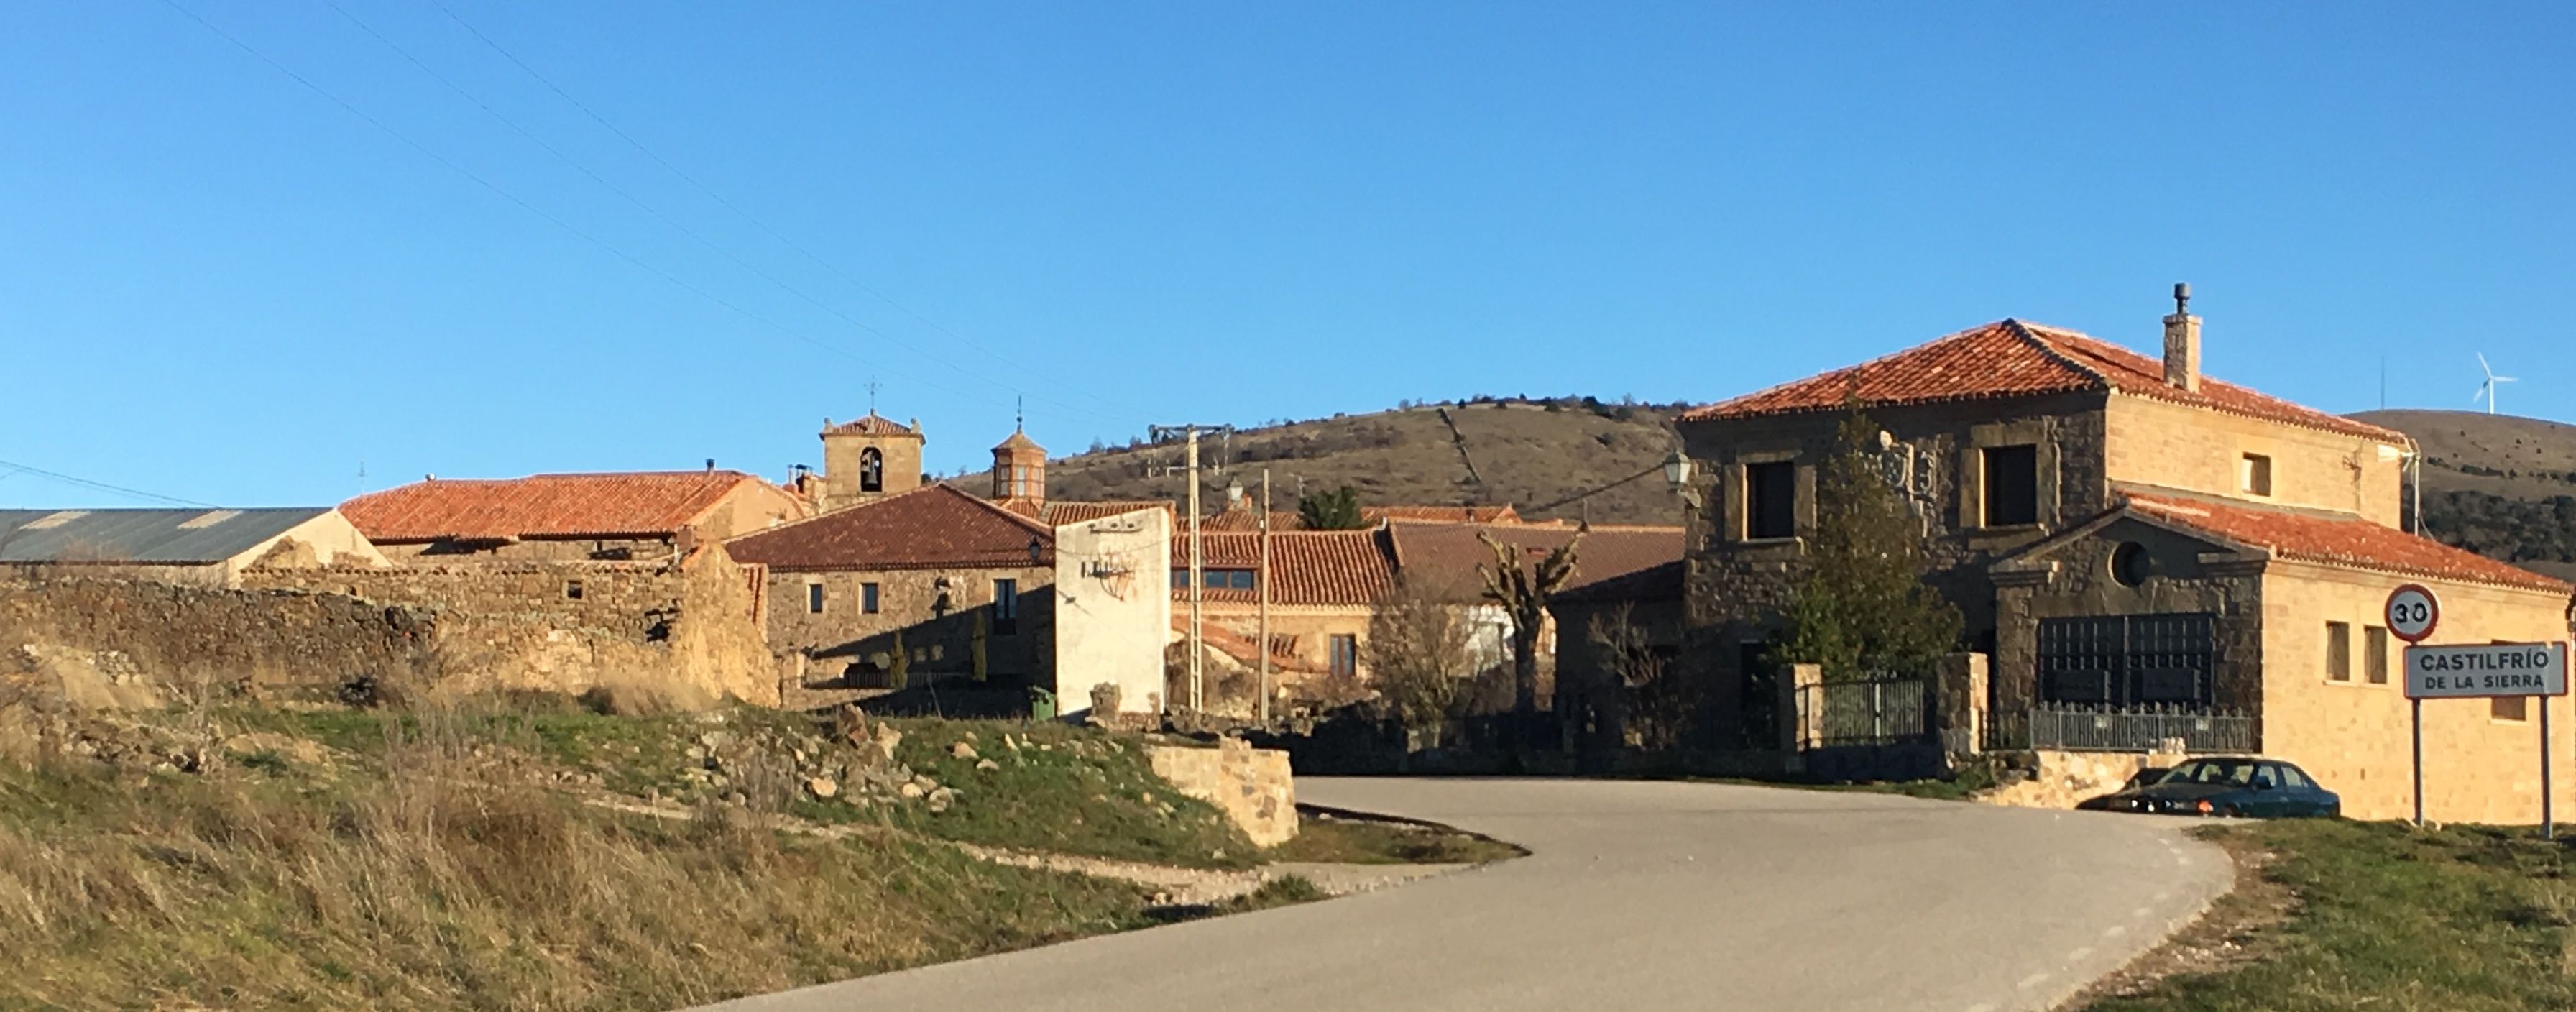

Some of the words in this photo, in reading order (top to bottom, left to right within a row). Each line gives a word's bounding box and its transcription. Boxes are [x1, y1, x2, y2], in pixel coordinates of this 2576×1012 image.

[2395, 602, 2428, 623] 30
[2420, 648, 2548, 671] CASTILFRÍO
[2425, 677, 2446, 689] DE
[2455, 676, 2473, 689] LA
[2484, 675, 2544, 688] SIERRA
